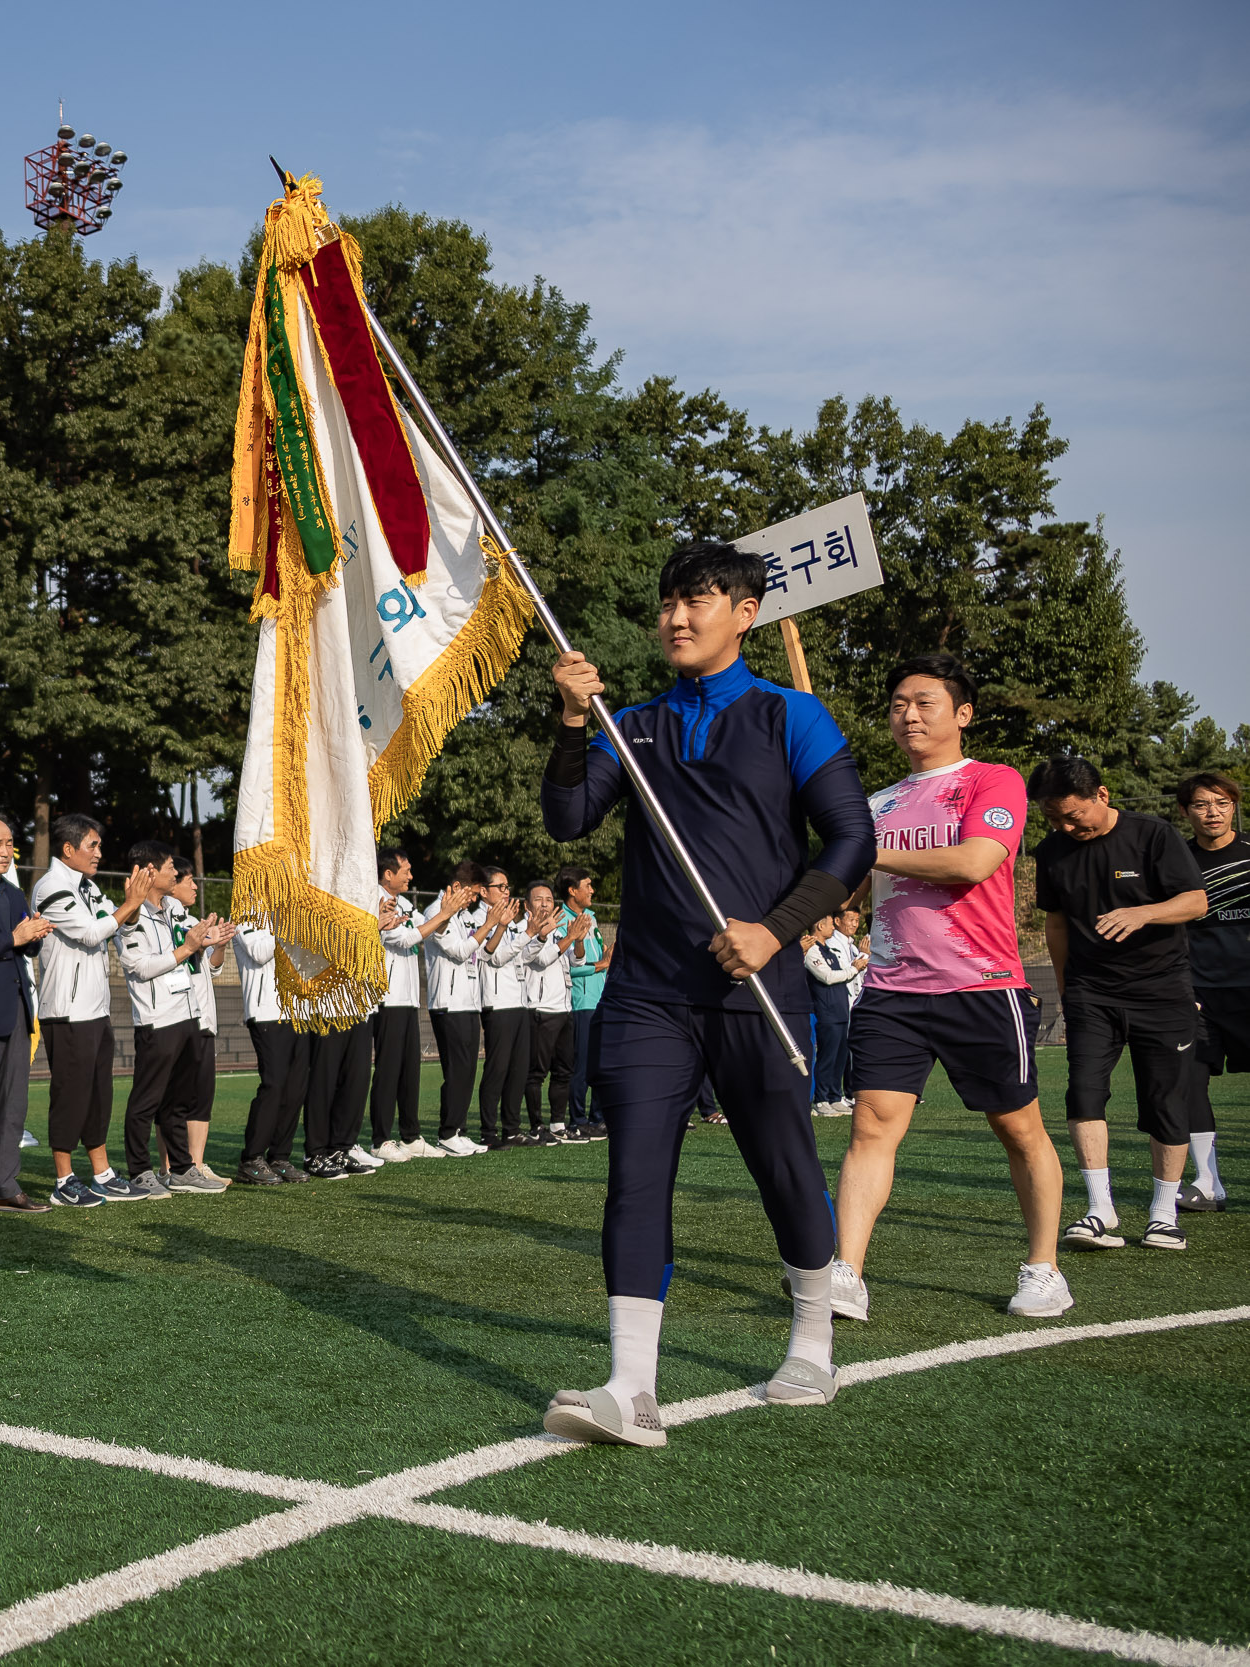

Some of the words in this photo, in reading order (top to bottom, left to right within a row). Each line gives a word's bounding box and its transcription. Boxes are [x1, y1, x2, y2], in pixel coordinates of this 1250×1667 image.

[761, 525, 858, 593] 축구회
[874, 823, 962, 851] ONGLI
[1217, 907, 1250, 921] NIK
